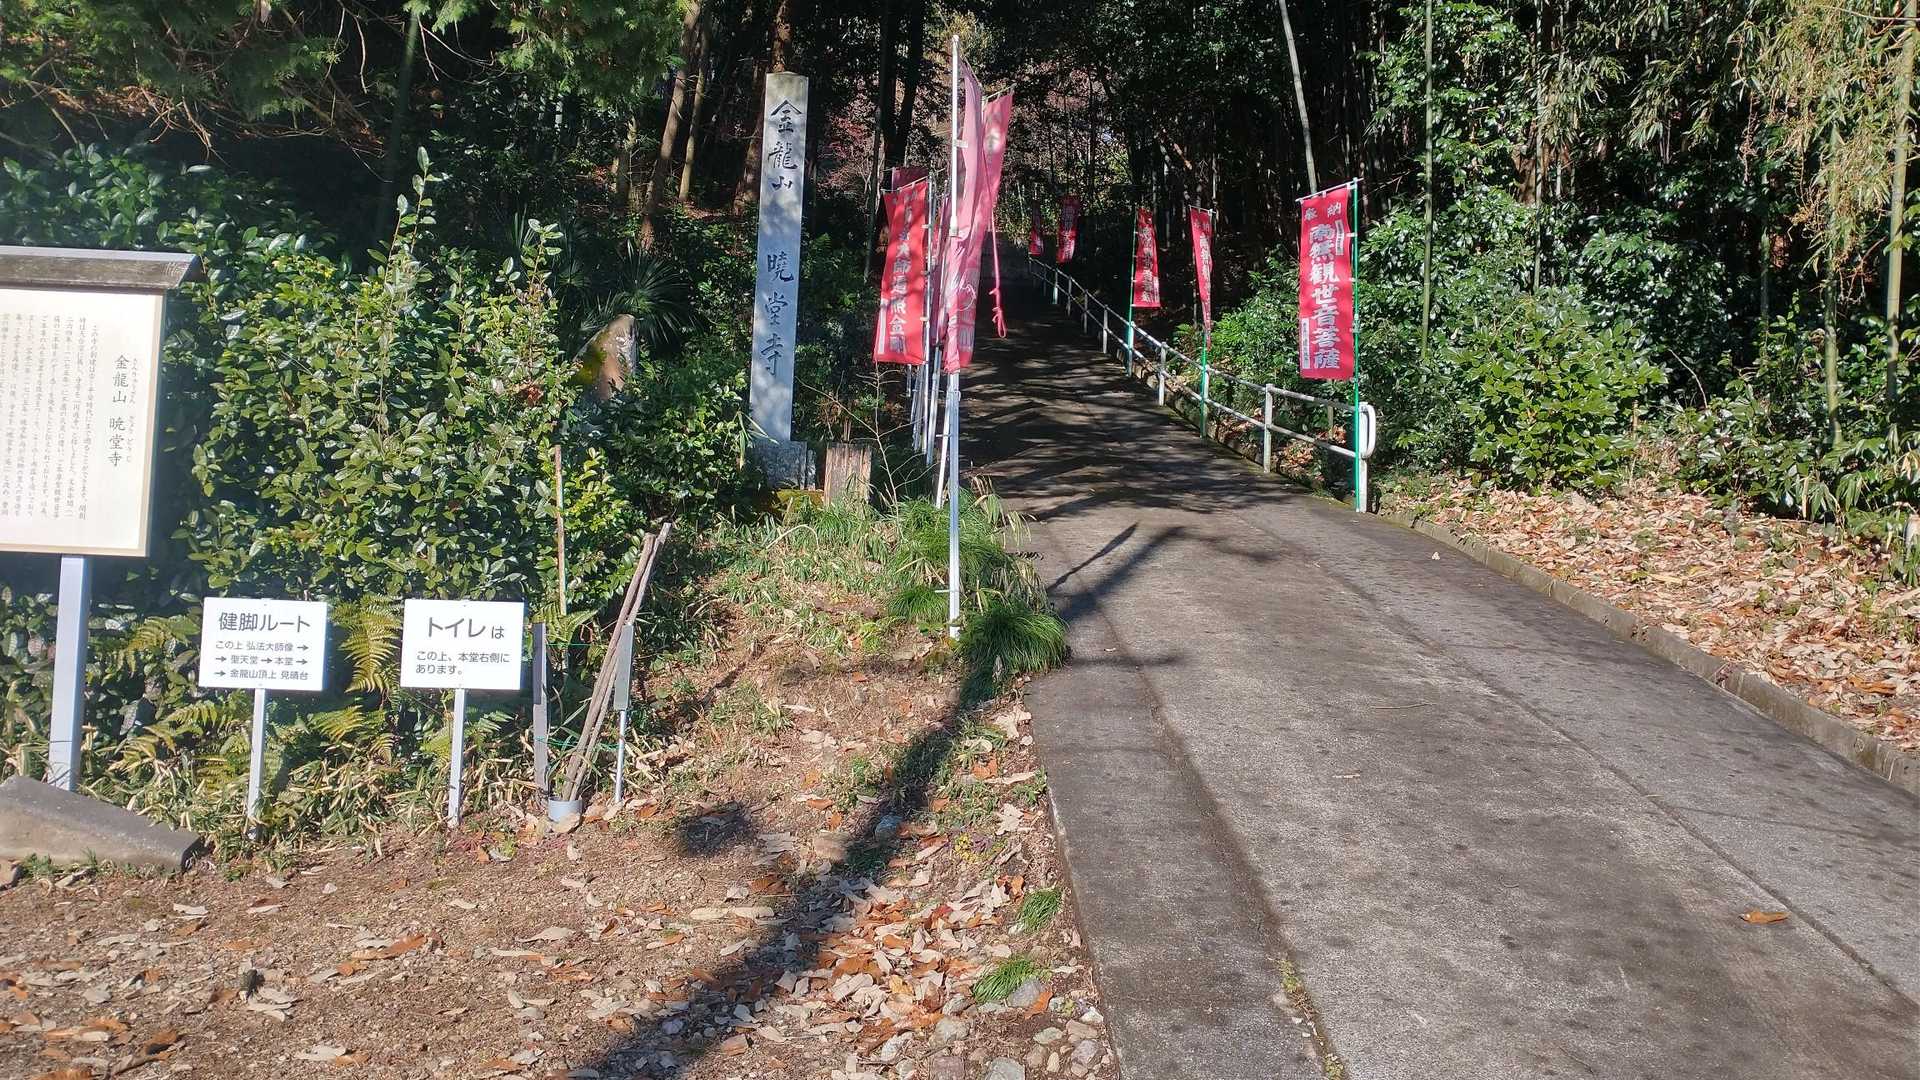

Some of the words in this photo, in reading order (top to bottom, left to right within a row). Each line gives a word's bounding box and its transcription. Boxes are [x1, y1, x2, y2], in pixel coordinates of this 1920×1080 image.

[768, 99, 802, 192] 金龍山
[112, 354, 130, 403] 金龍山
[219, 612, 311, 633] 健脚ルート
[215, 640, 243, 650] この上
[415, 664, 463, 676] あります。
